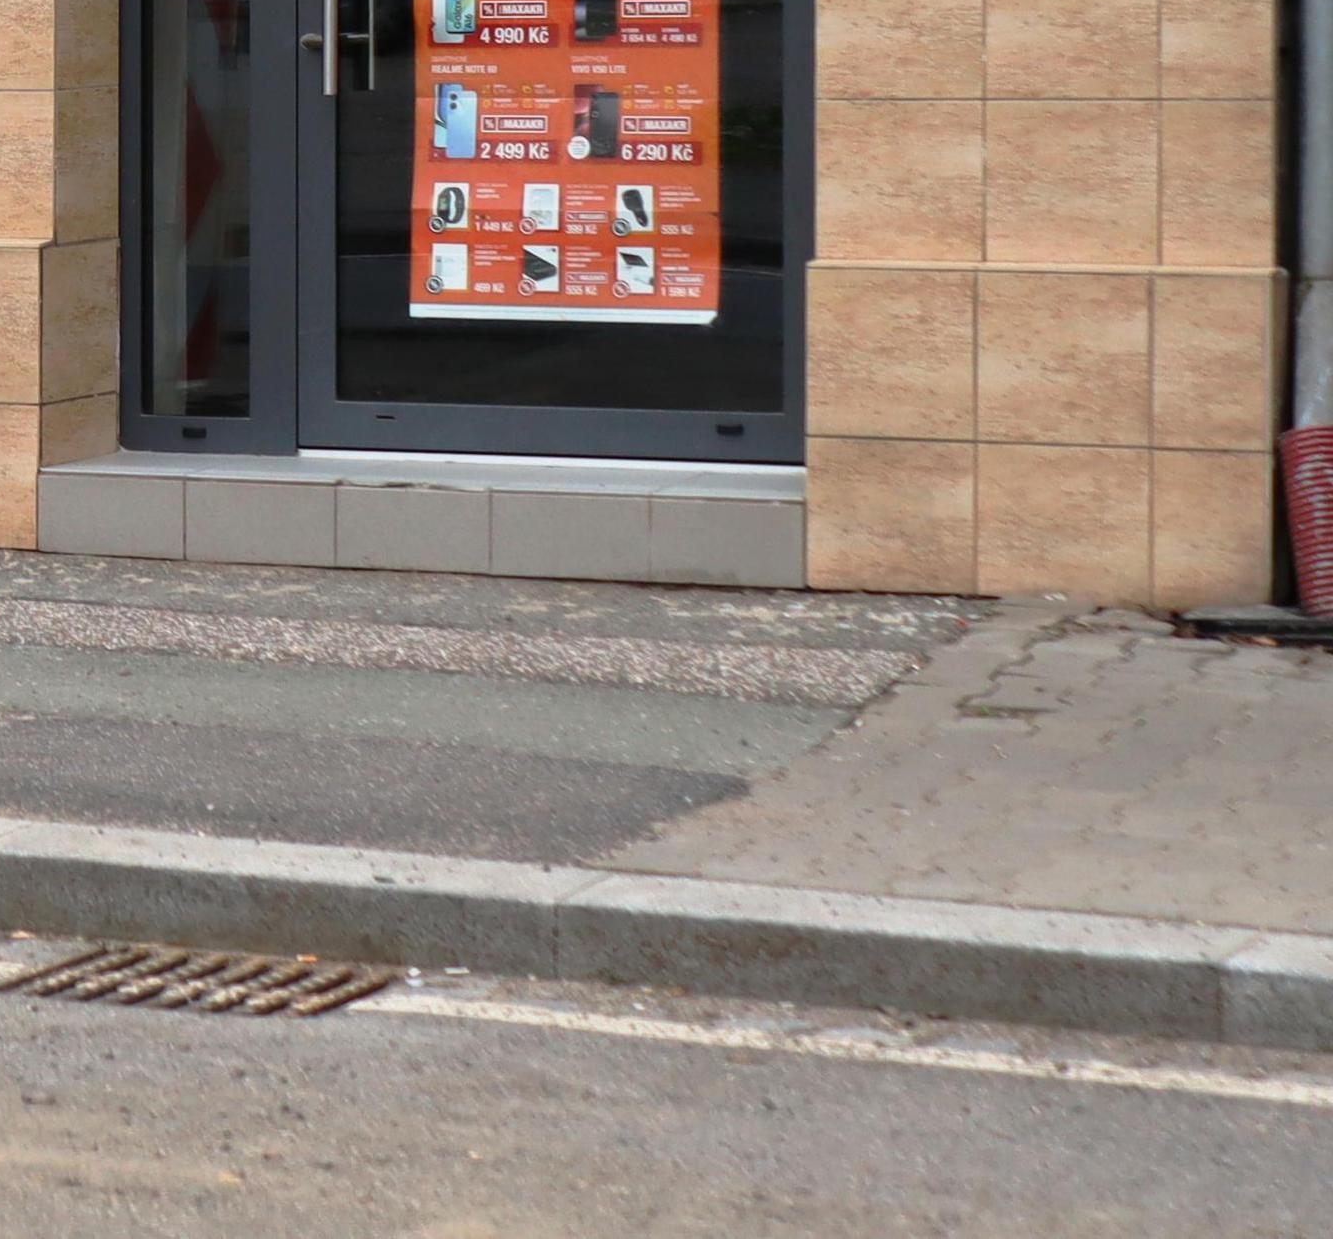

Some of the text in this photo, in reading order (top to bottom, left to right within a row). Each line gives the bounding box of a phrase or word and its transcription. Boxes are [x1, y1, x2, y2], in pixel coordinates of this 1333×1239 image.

[480, 26, 549, 43] 4 990 Kč
[481, 142, 550, 159] 2 499 Kč
[621, 144, 694, 161] 6 290 Kč
